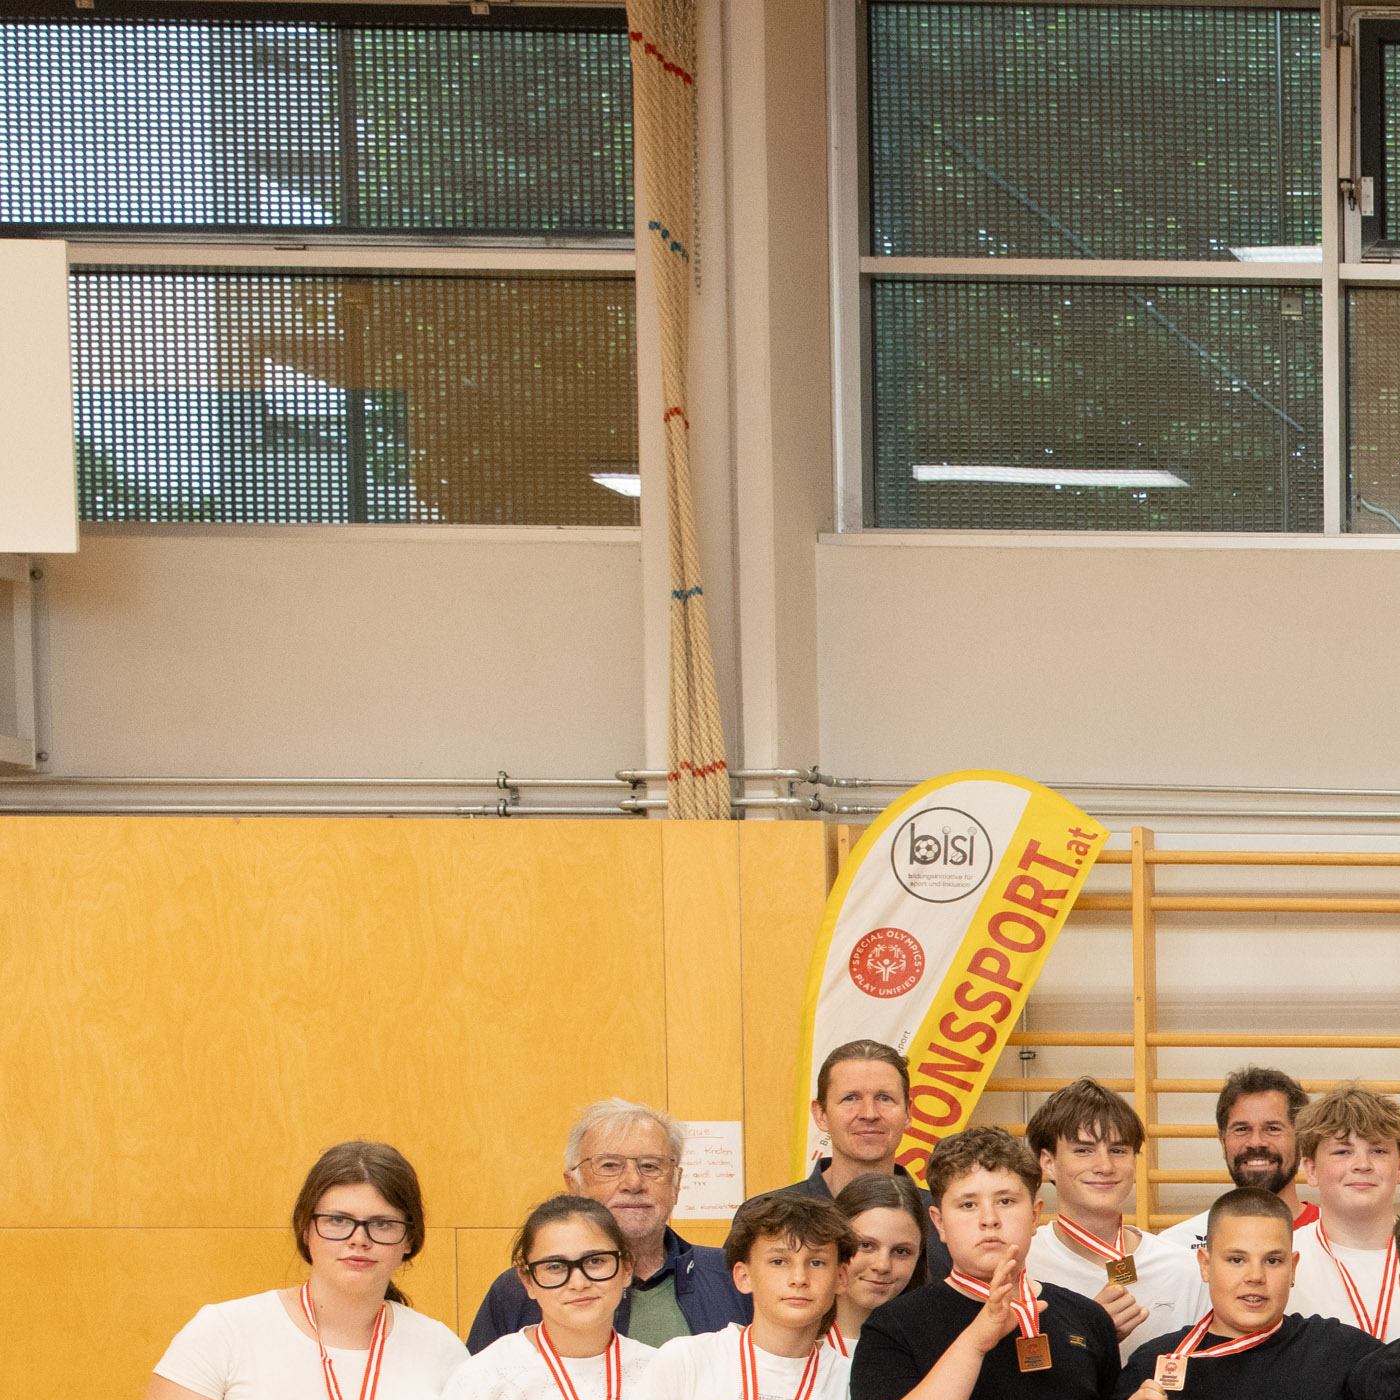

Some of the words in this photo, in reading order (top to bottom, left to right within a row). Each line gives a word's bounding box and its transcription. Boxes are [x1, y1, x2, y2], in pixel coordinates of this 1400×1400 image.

[909, 822, 978, 866] bisi
[852, 932, 884, 965] SPECIAL
[886, 930, 922, 967] OLYMPICS
[855, 974, 876, 992] PLAY
[878, 975, 916, 996] UNIFIED
[897, 826, 1099, 1182] SIONSSPORT.at
